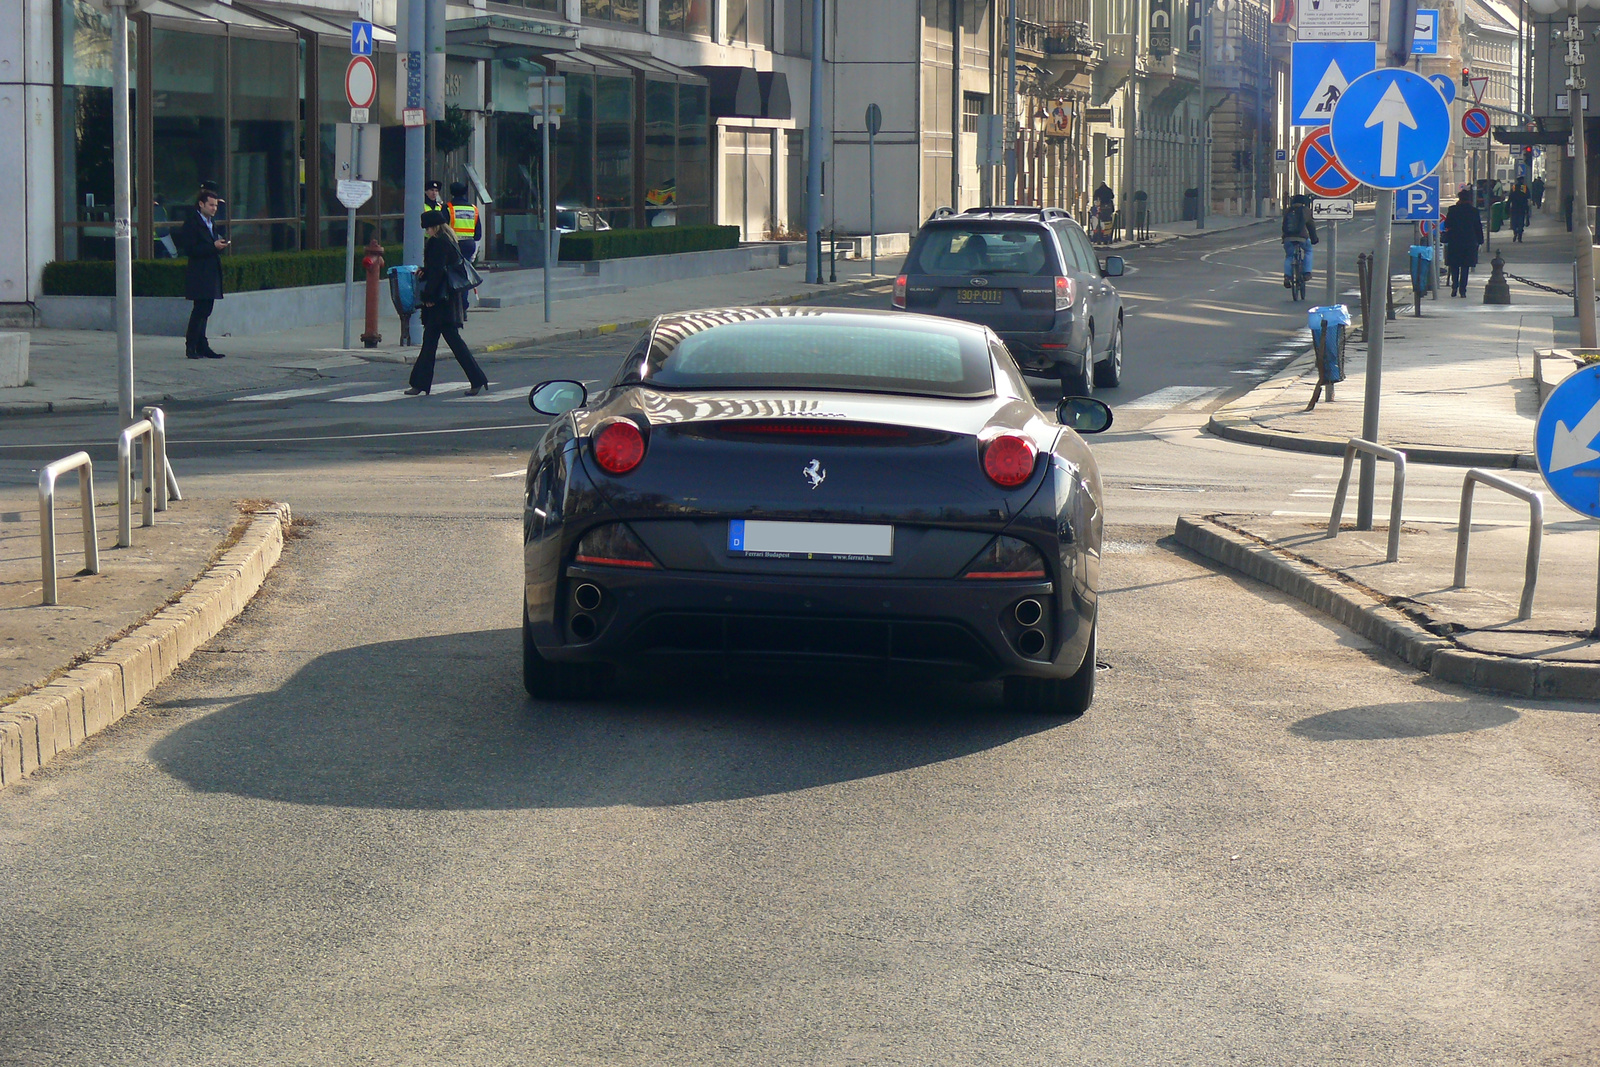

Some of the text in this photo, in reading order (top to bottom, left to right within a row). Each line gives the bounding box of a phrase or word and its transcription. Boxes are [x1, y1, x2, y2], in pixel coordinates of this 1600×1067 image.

[1277, 151, 1284, 159] P
[1407, 189, 1427, 214] P
[733, 538, 740, 546] D
[764, 551, 790, 559] Budapest
